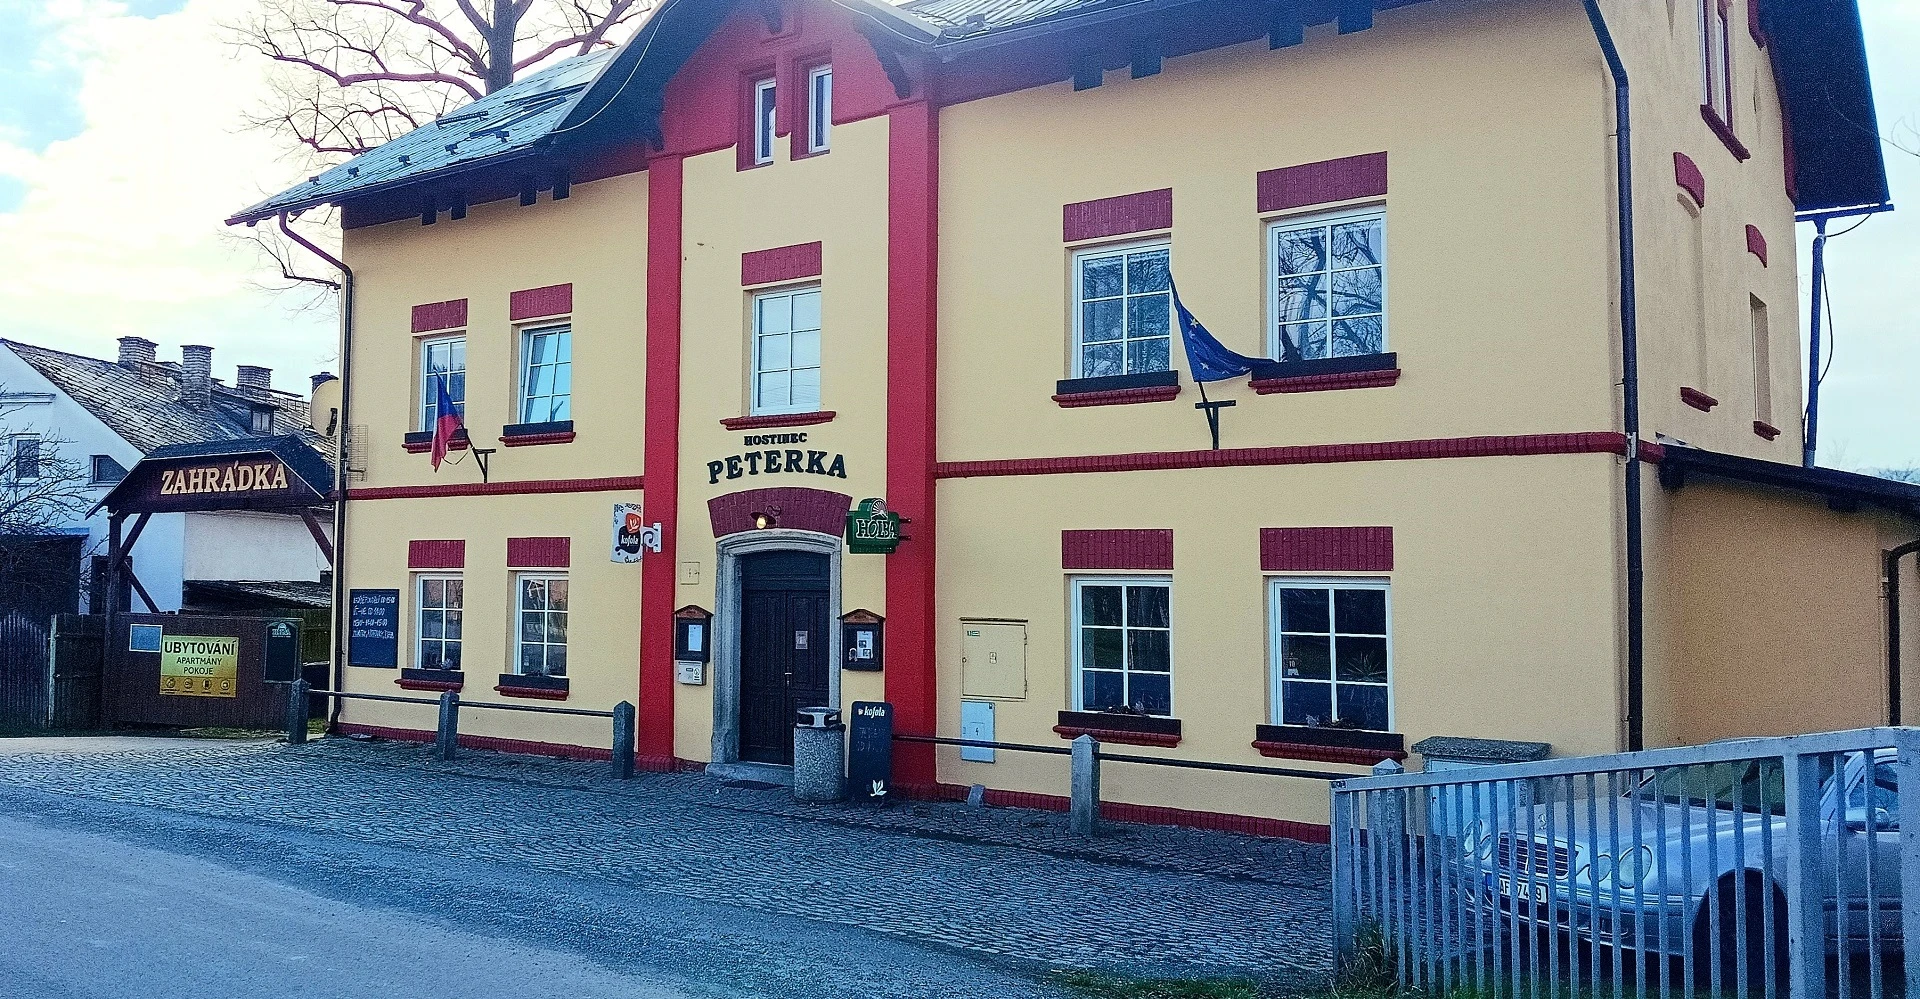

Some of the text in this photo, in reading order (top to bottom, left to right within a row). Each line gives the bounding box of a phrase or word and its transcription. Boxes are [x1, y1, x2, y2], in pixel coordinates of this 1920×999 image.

[744, 433, 808, 446] HOSTINEC
[706, 449, 848, 485] PETERKA
[160, 460, 288, 495] ZAHRÁDKA
[856, 518, 898, 540] HOLBA
[621, 534, 640, 547] kofola
[164, 639, 237, 656] UBYTOVÁNÍ
[176, 656, 223, 666] APARTMÁNY
[183, 667, 214, 675] POKOJE
[863, 705, 886, 718] kofola
[1517, 884, 1542, 901] 749
